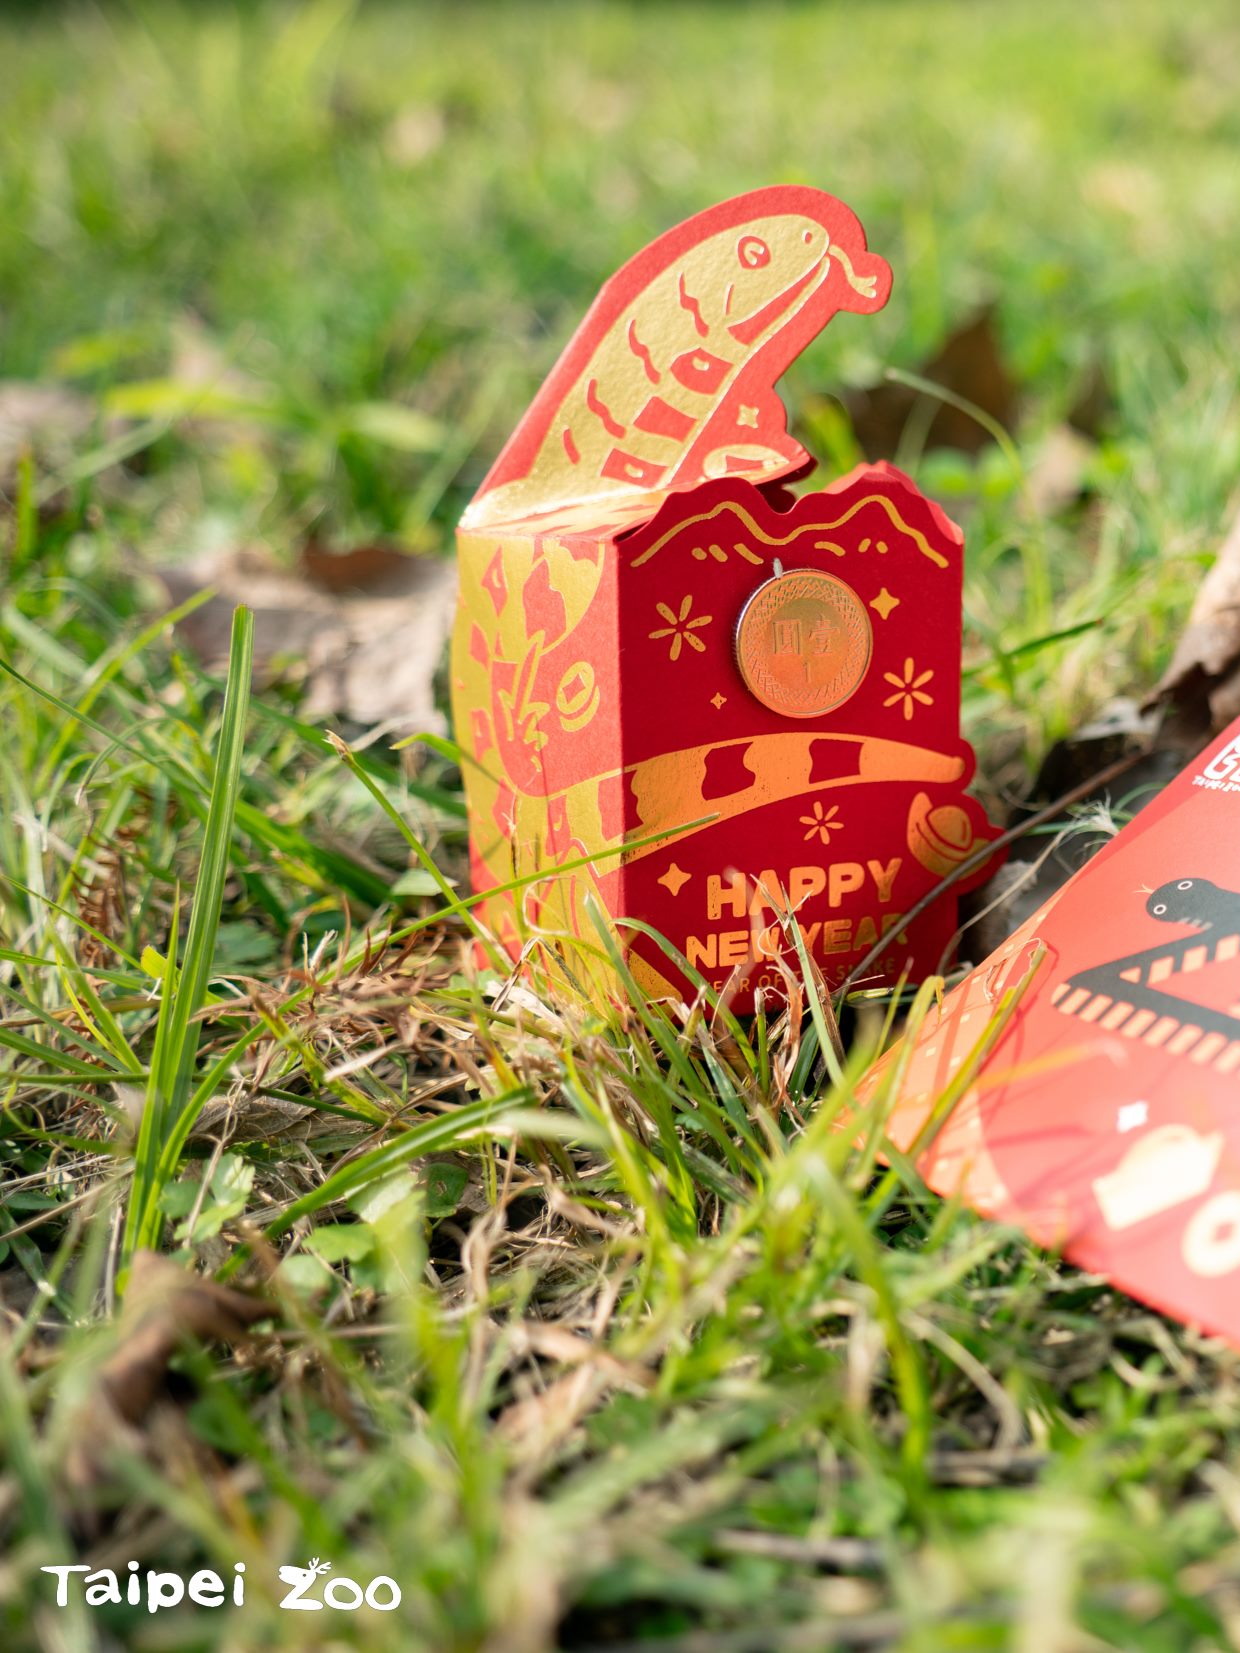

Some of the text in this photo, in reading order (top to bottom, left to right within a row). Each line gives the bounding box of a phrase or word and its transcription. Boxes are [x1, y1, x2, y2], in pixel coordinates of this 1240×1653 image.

[707, 858, 902, 920] HAPPY
[686, 913, 908, 968] NEW YEAR
